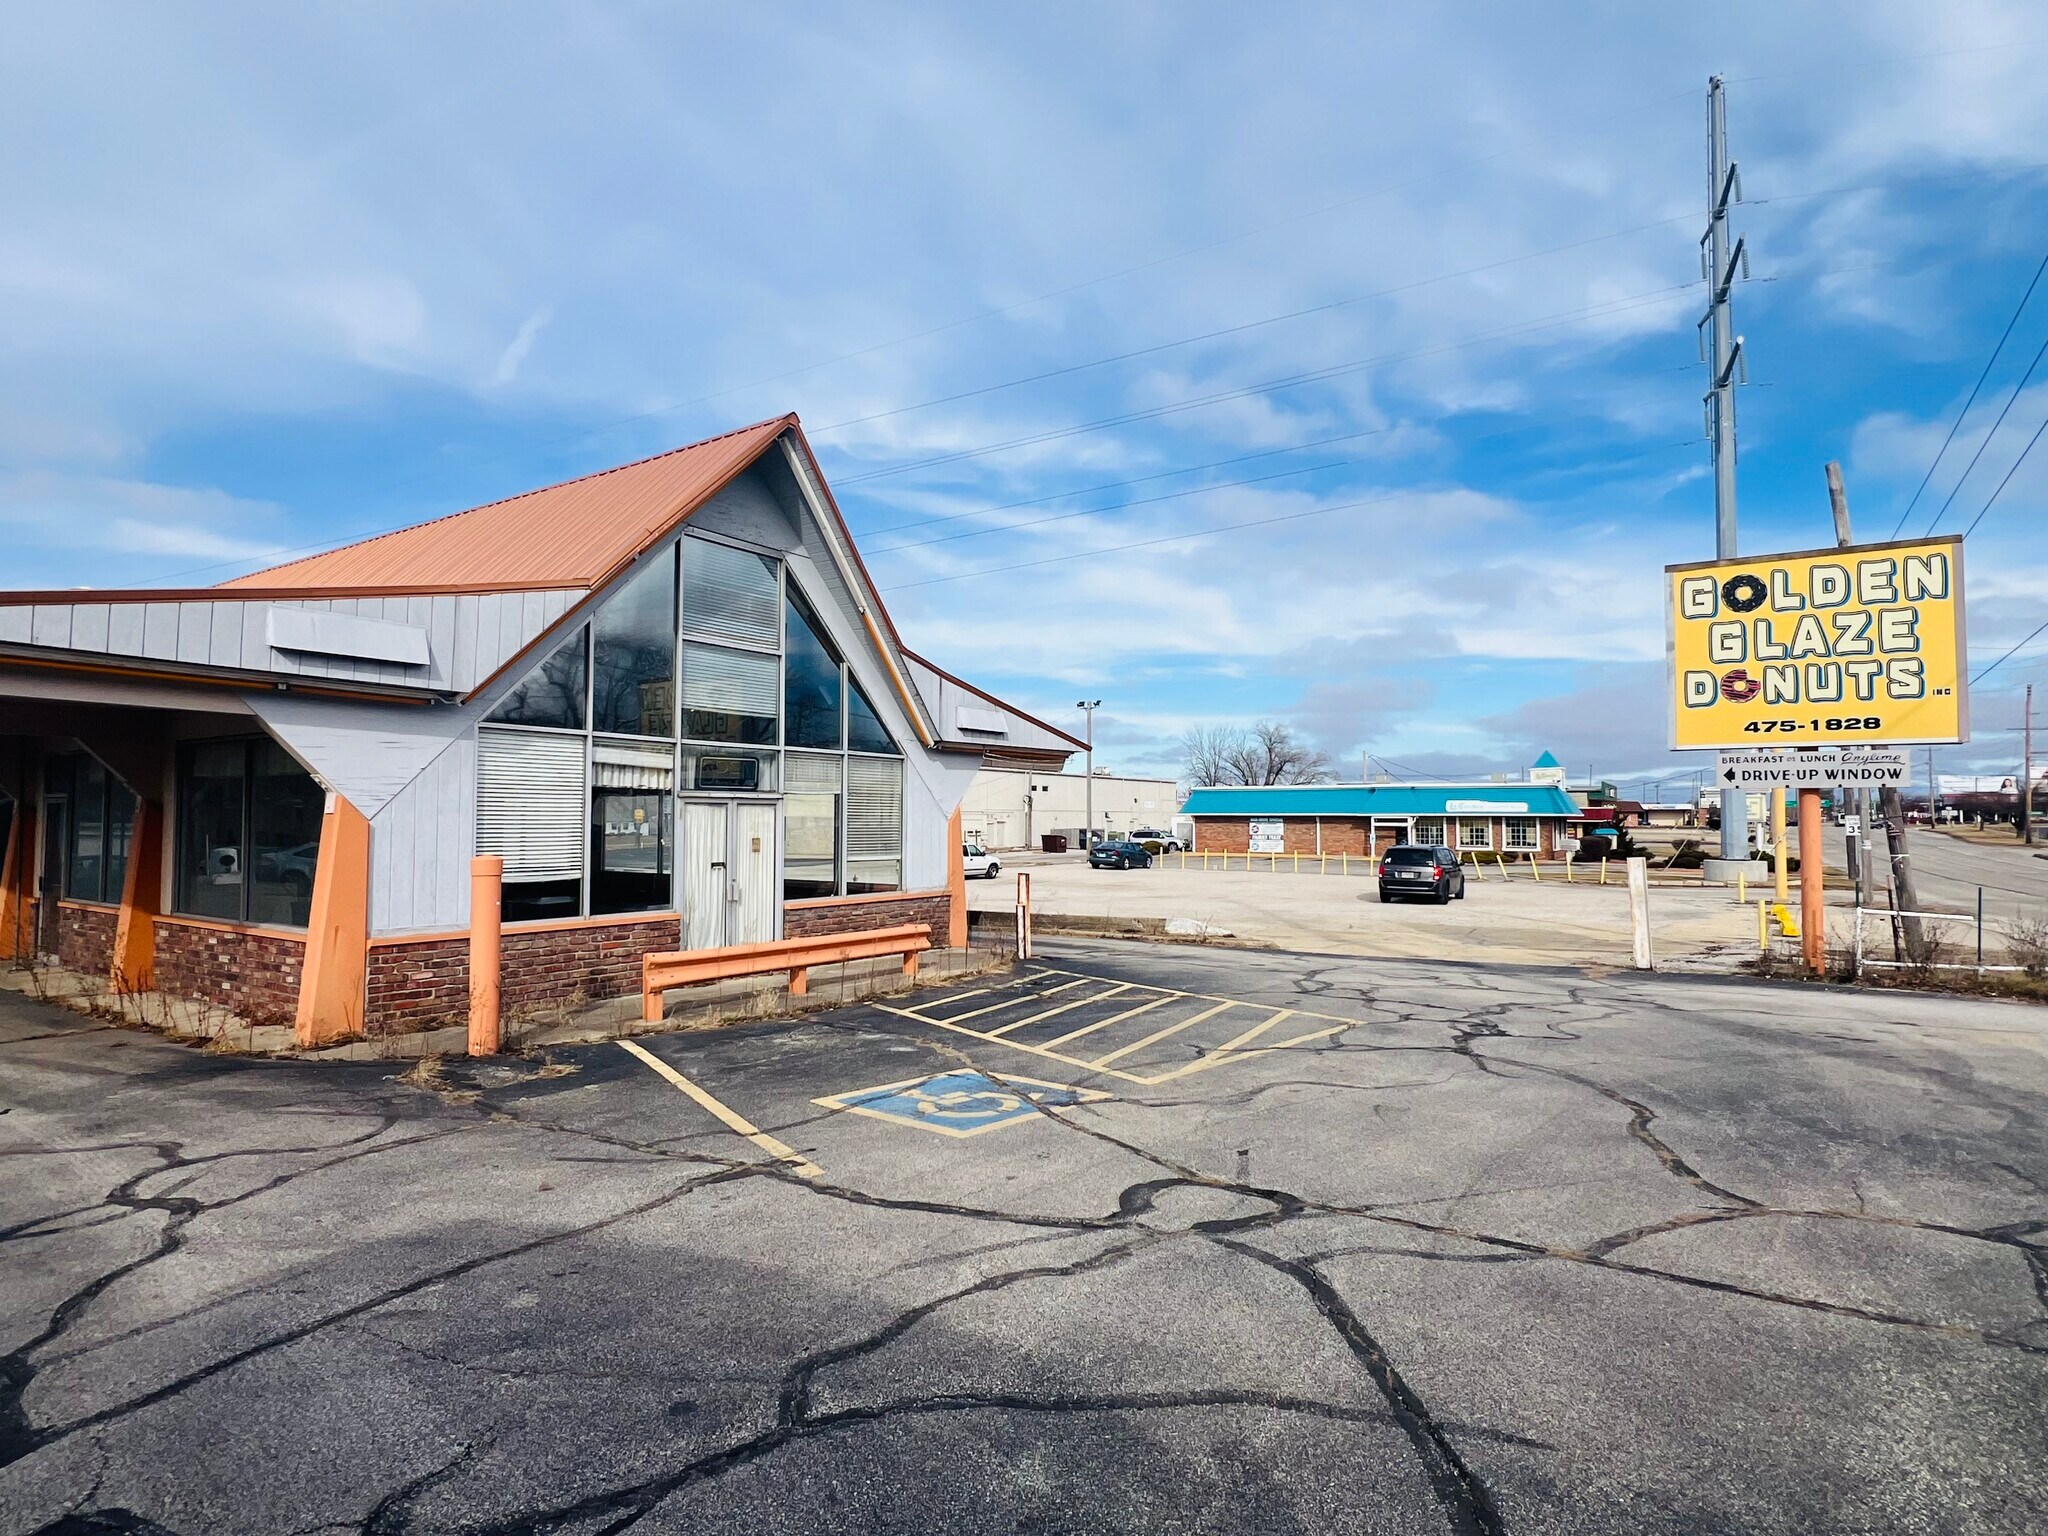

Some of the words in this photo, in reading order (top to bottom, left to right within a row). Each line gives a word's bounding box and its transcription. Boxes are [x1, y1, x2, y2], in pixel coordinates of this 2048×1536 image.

[1681, 553, 1948, 619] GOLDEN
[1708, 606, 1920, 664] GLAZE
[1684, 657, 1925, 708] DONUTS
[1932, 687, 1951, 696] INC
[1743, 717, 1881, 733] 475-1828
[1722, 755, 1784, 764] BREAKFAST
[1800, 754, 1836, 763] LUNCH
[1742, 769, 1819, 781] DRIVE-UP
[1824, 768, 1902, 780] WINDOW
